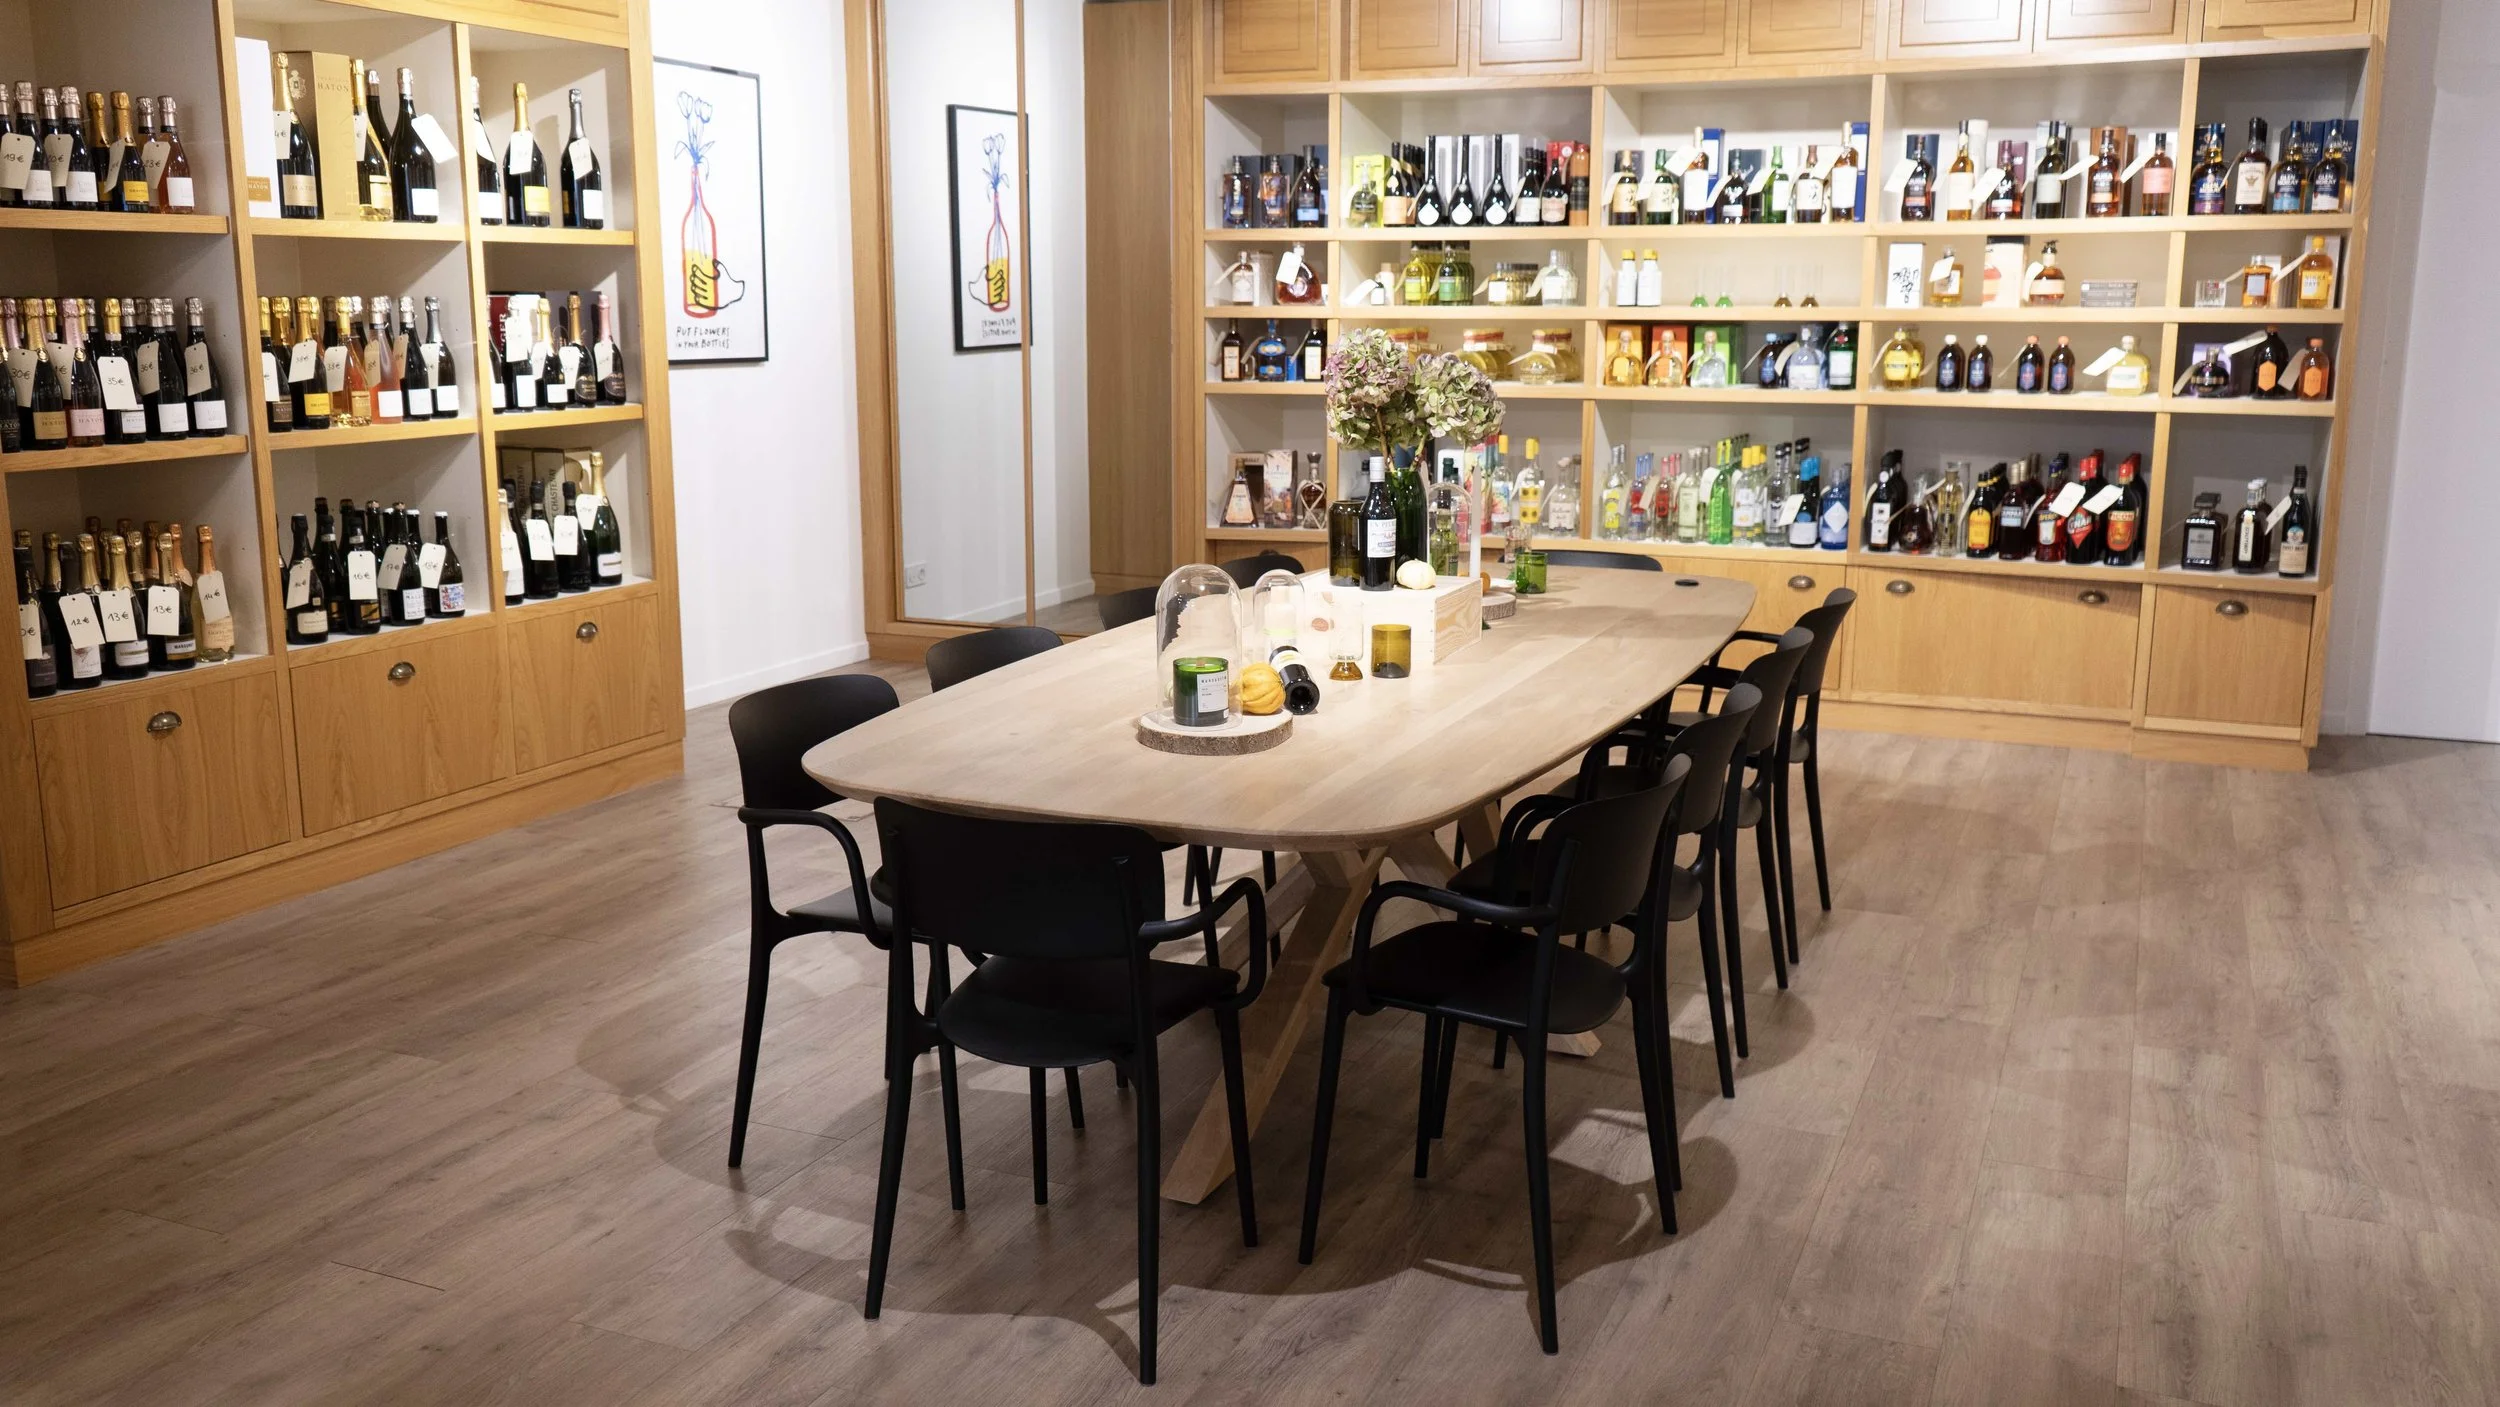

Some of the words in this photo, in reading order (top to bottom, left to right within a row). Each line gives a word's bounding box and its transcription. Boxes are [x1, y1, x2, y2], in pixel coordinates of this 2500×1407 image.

[317, 82, 349, 92] HATON
[3, 153, 24, 163] 19€
[677, 326, 691, 337] PUT
[694, 326, 730, 337] FLOWERS
[107, 377, 125, 386] 35€
[153, 605, 172, 614] 13€
[71, 616, 89, 626] 12€
[107, 611, 129, 621] 13€
